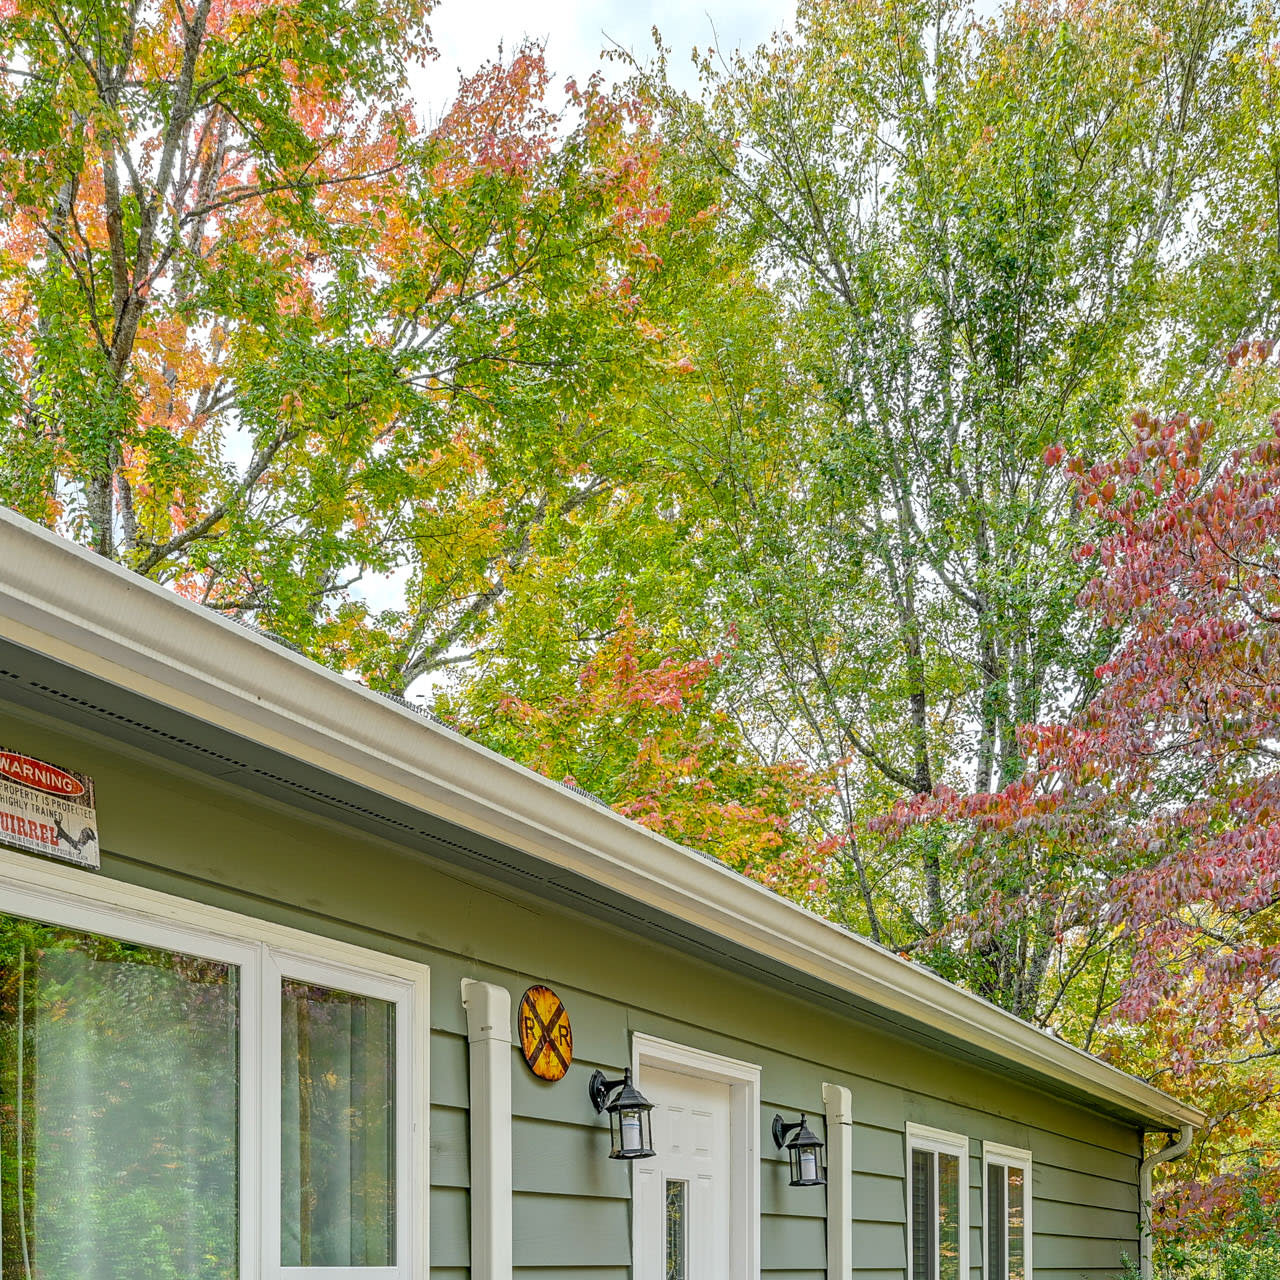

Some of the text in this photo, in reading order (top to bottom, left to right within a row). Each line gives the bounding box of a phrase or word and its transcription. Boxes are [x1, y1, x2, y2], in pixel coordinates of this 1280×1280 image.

[0, 782, 39, 802] PROPERTY
[42, 796, 50, 806] IS
[52, 799, 93, 820] PROTECTED
[0, 794, 29, 810] HIGHLY
[31, 803, 63, 821] TRAINED
[524, 1016, 571, 1048] R R
